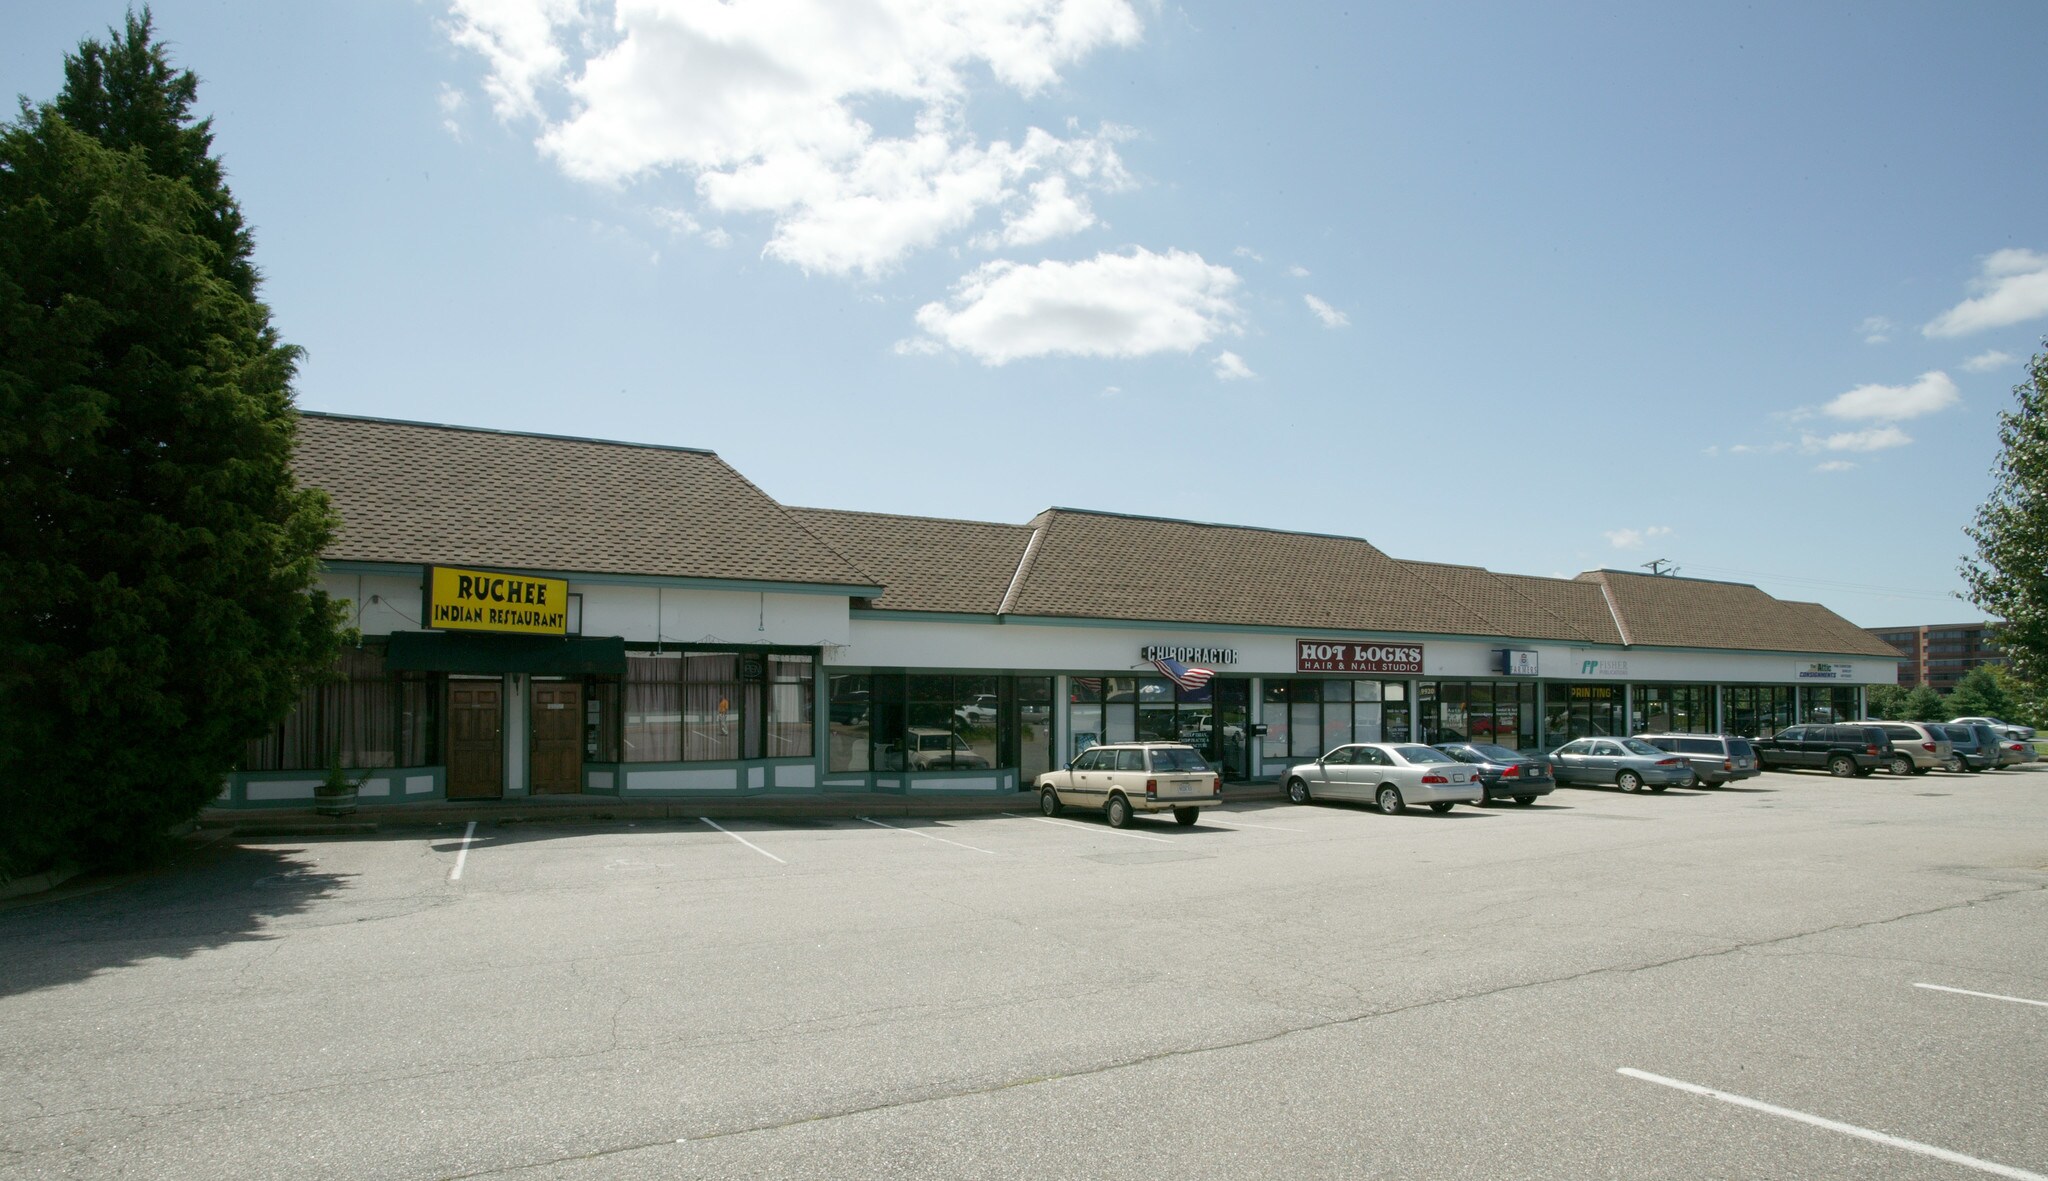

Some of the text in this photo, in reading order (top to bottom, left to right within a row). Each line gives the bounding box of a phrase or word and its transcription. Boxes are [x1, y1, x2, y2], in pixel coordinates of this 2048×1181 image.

[457, 575, 547, 606] RUCHEE
[434, 604, 564, 629] INDIAN RESTAURANT
[1147, 645, 1240, 665] CHIROPRACTOR
[1301, 644, 1422, 664] HOT LOCKS
[1304, 661, 1419, 672] HAIR & NAIL STUDIO
[1510, 665, 1538, 675] FARMERS
[1599, 660, 1629, 670] FISHER
[1420, 687, 1436, 696] 9920
[1571, 687, 1612, 698] PRINTING
